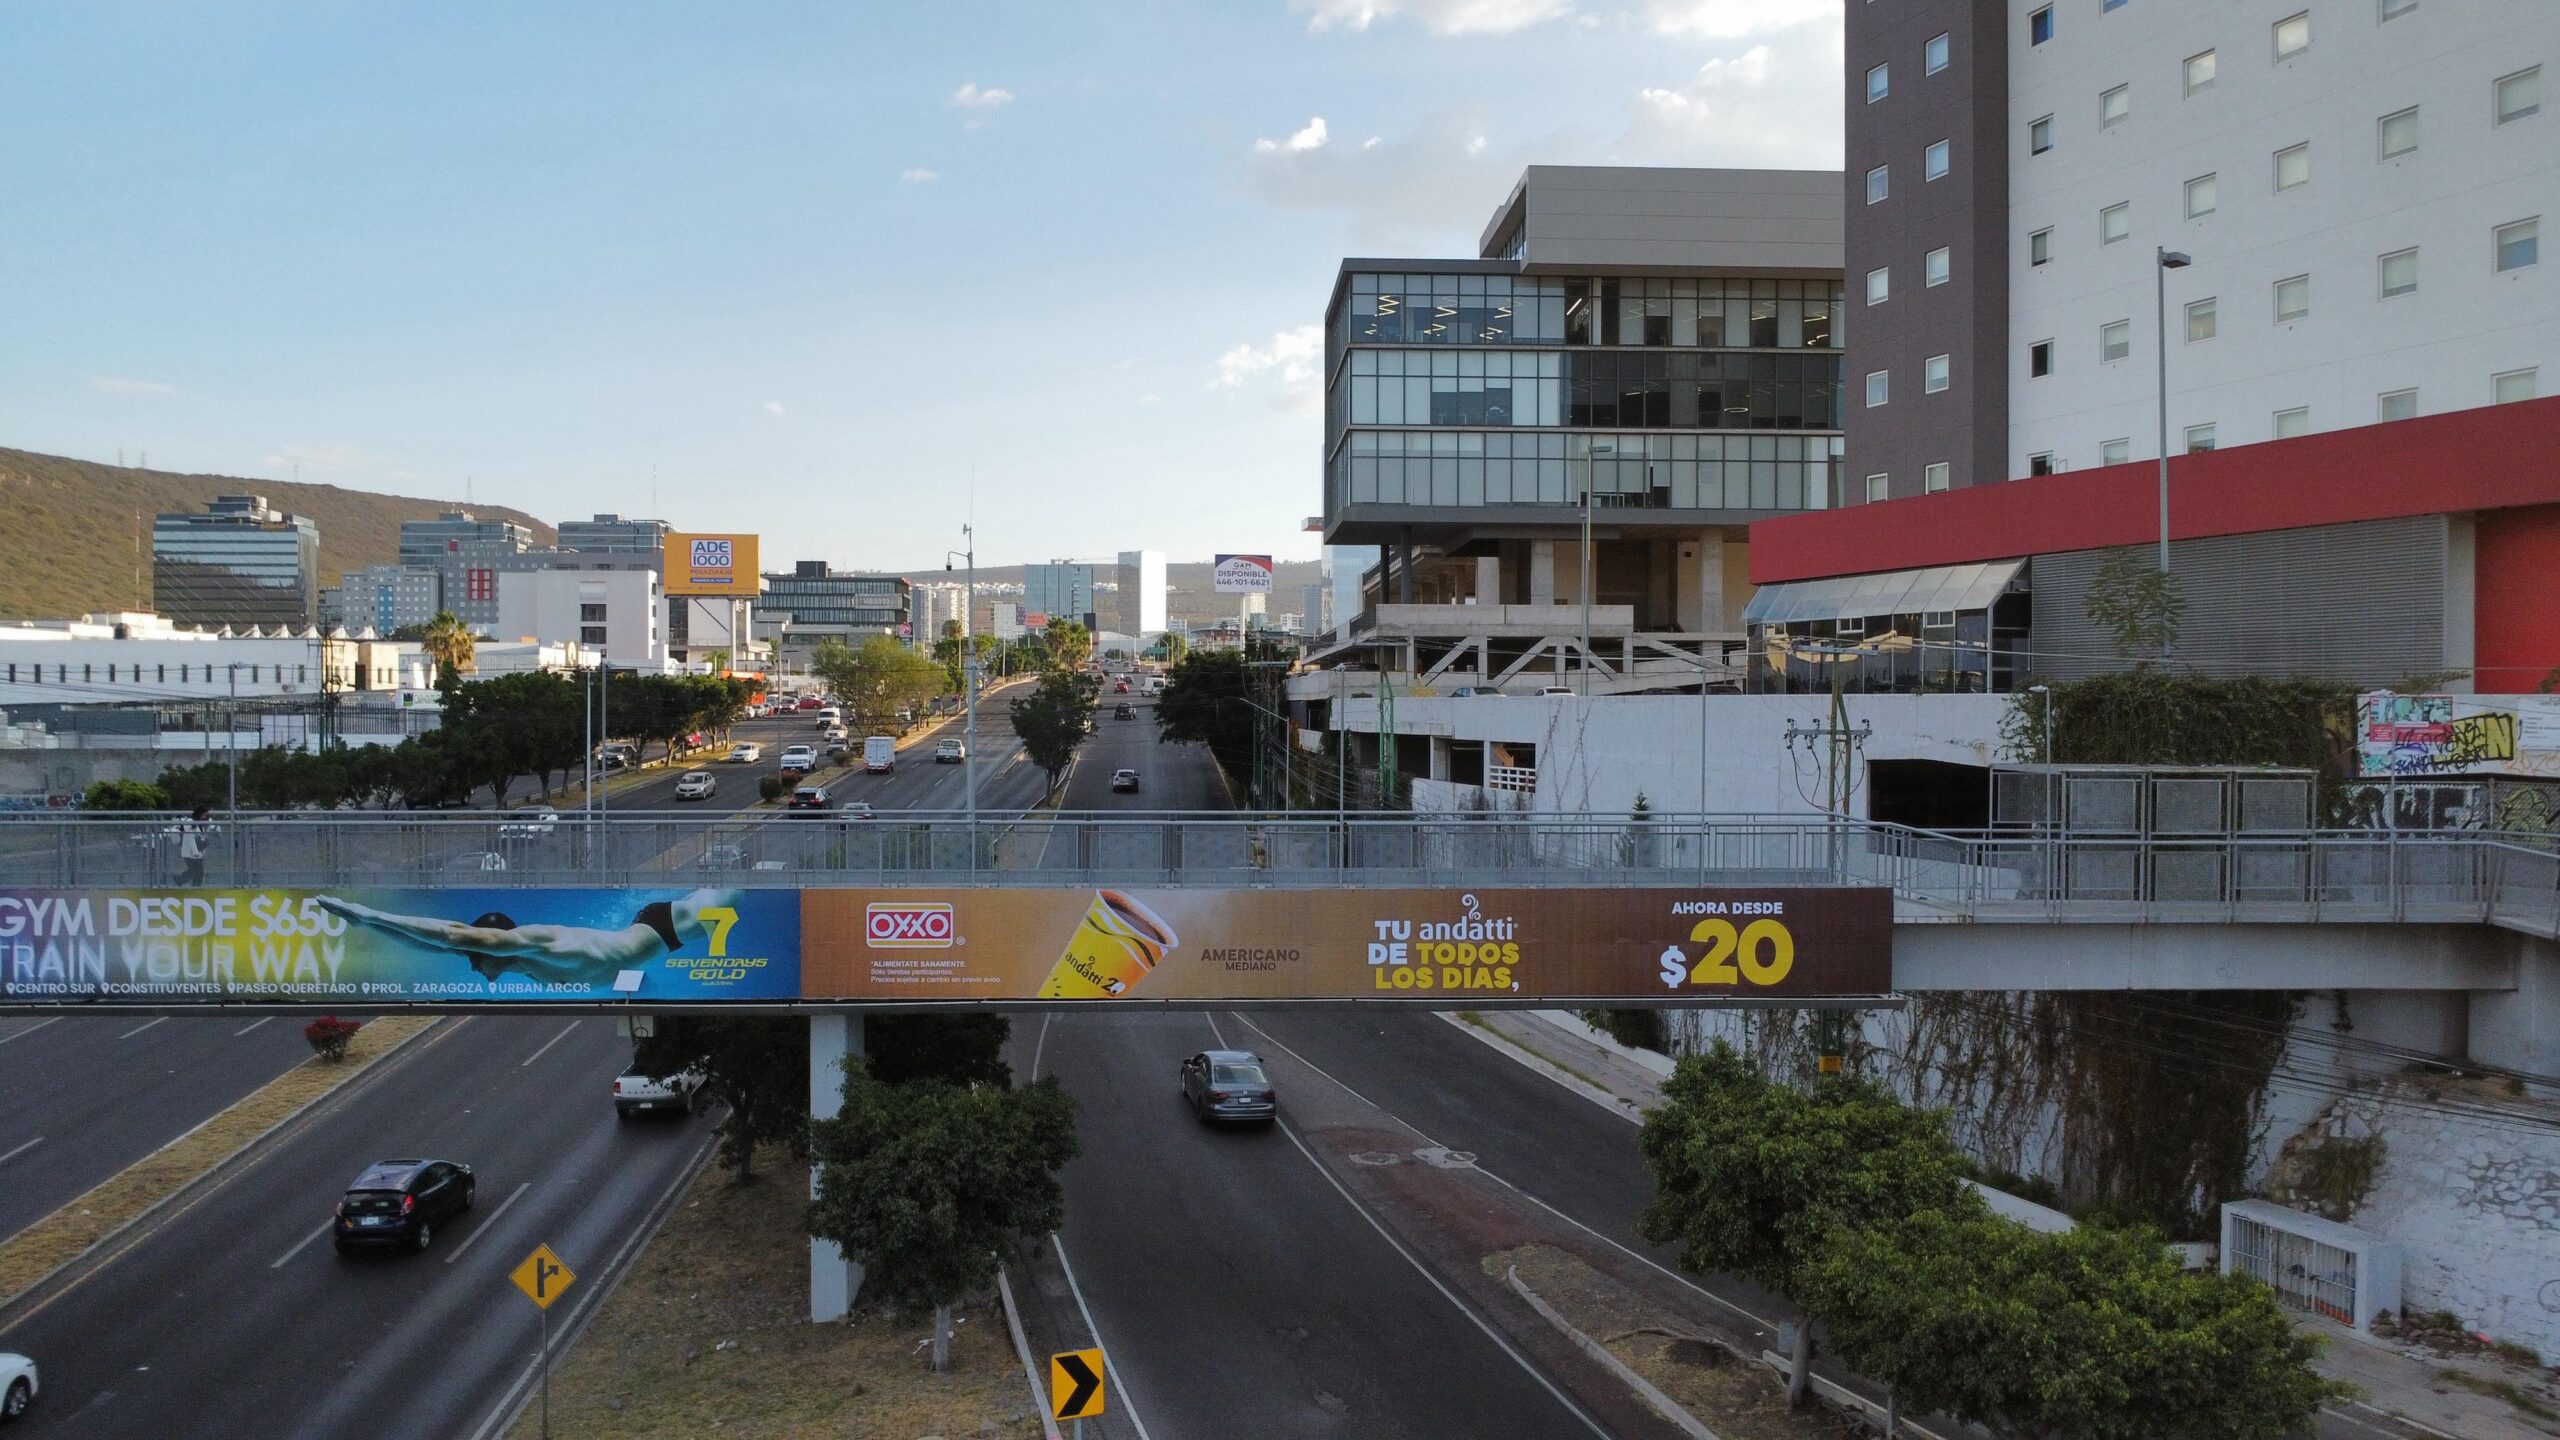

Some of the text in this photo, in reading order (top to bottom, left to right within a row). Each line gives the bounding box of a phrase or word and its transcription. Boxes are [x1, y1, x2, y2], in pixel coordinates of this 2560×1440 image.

[694, 541, 729, 553] ADE
[693, 555, 730, 566] 1000
[1218, 570, 1267, 578] DISPONIBLE
[1216, 578, 1270, 587] 446-101-6621
[1672, 902, 1783, 915] AHORA DESDE
[0, 895, 348, 942] GYM DESDE $650
[870, 911, 950, 940] OXXO
[1374, 916, 1513, 941] TU andatti
[697, 907, 739, 957] 7
[1201, 949, 1300, 961] AMERICANO
[1368, 942, 1520, 965] DE TODOS
[121, 938, 235, 983] YOUR
[250, 938, 346, 983] WAY
[665, 959, 769, 968] SEVENDAYS
[1225, 962, 1276, 971] MEDIANO
[688, 969, 747, 980] GOLD
[1065, 951, 1104, 986] andatti
[1375, 967, 1434, 989] LOS
[15, 983, 68, 994] CENTRO
[70, 983, 96, 994] SUR
[110, 983, 222, 994] CONSTITUYENTES
[235, 983, 278, 994] PASEO
[371, 983, 408, 994] PROL.
[412, 983, 484, 994] ZARAGOZA
[499, 982, 543, 994] URBAN
[545, 982, 591, 994] ARCOS
